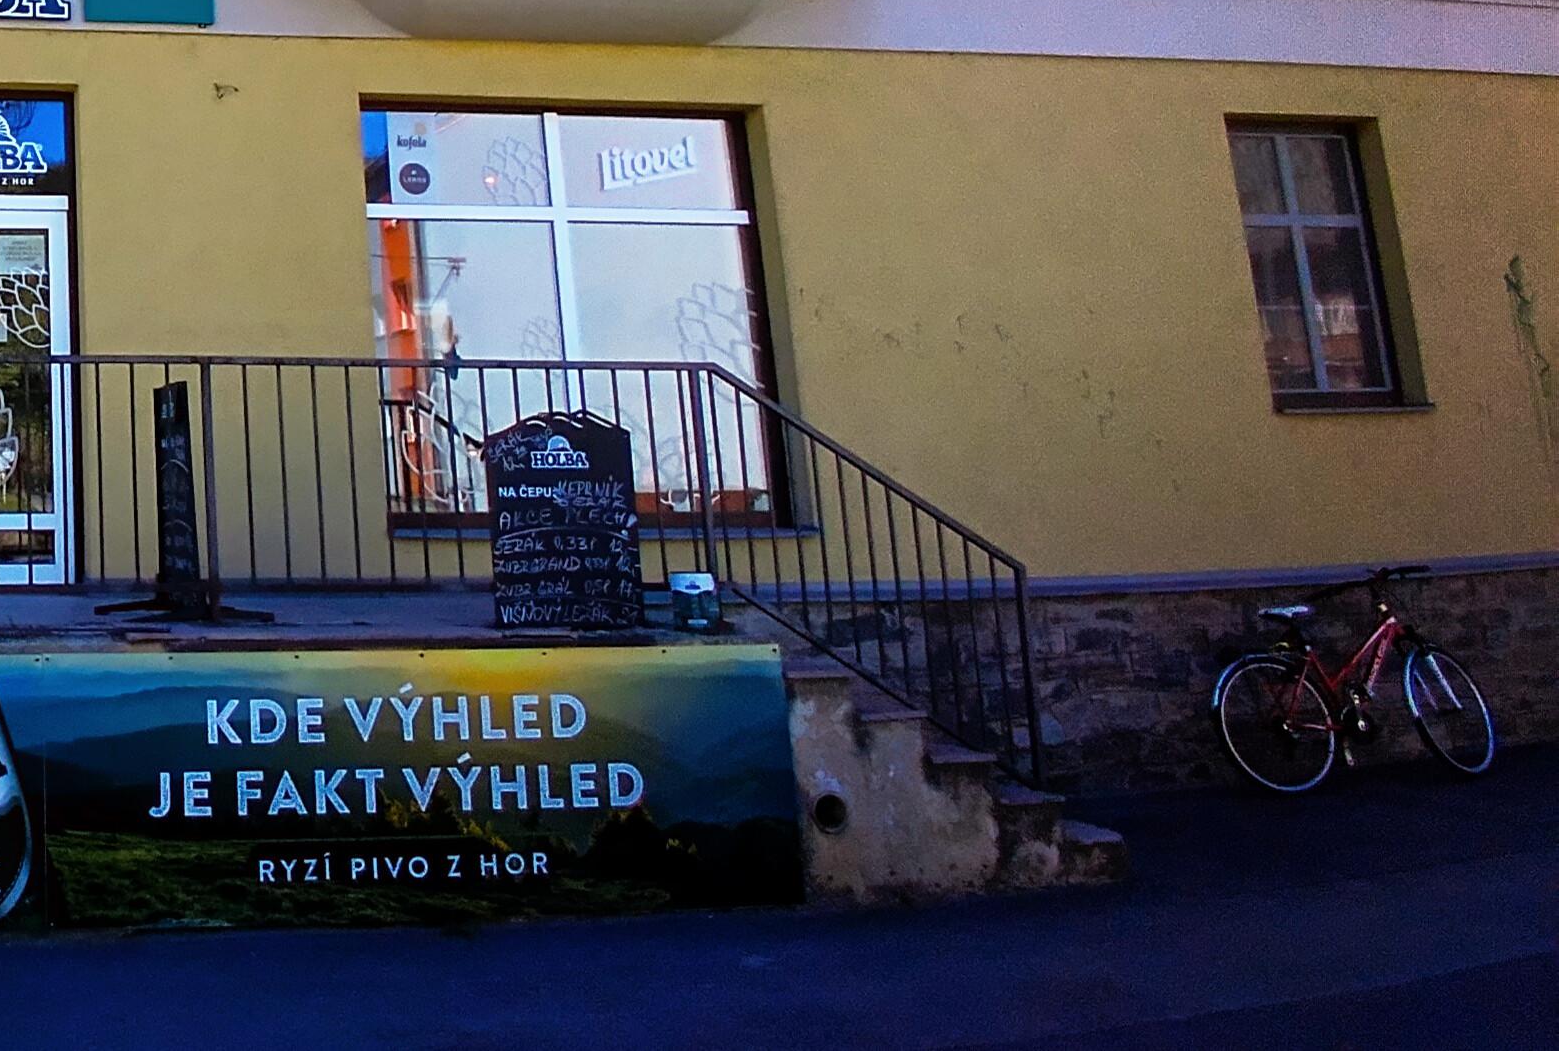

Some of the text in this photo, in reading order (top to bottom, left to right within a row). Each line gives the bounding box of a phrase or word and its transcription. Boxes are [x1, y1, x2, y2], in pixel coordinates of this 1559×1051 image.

[1, 177, 9, 186] Z
[12, 177, 35, 186] HOR
[530, 450, 590, 468] HOLBA
[498, 486, 518, 498] NA
[498, 507, 554, 532] AKCE
[205, 682, 588, 745] KDE VÝHLED
[148, 751, 646, 818] JE FAKT VÝHLED
[258, 851, 549, 883] RYZÍ PIVO Z HOR
